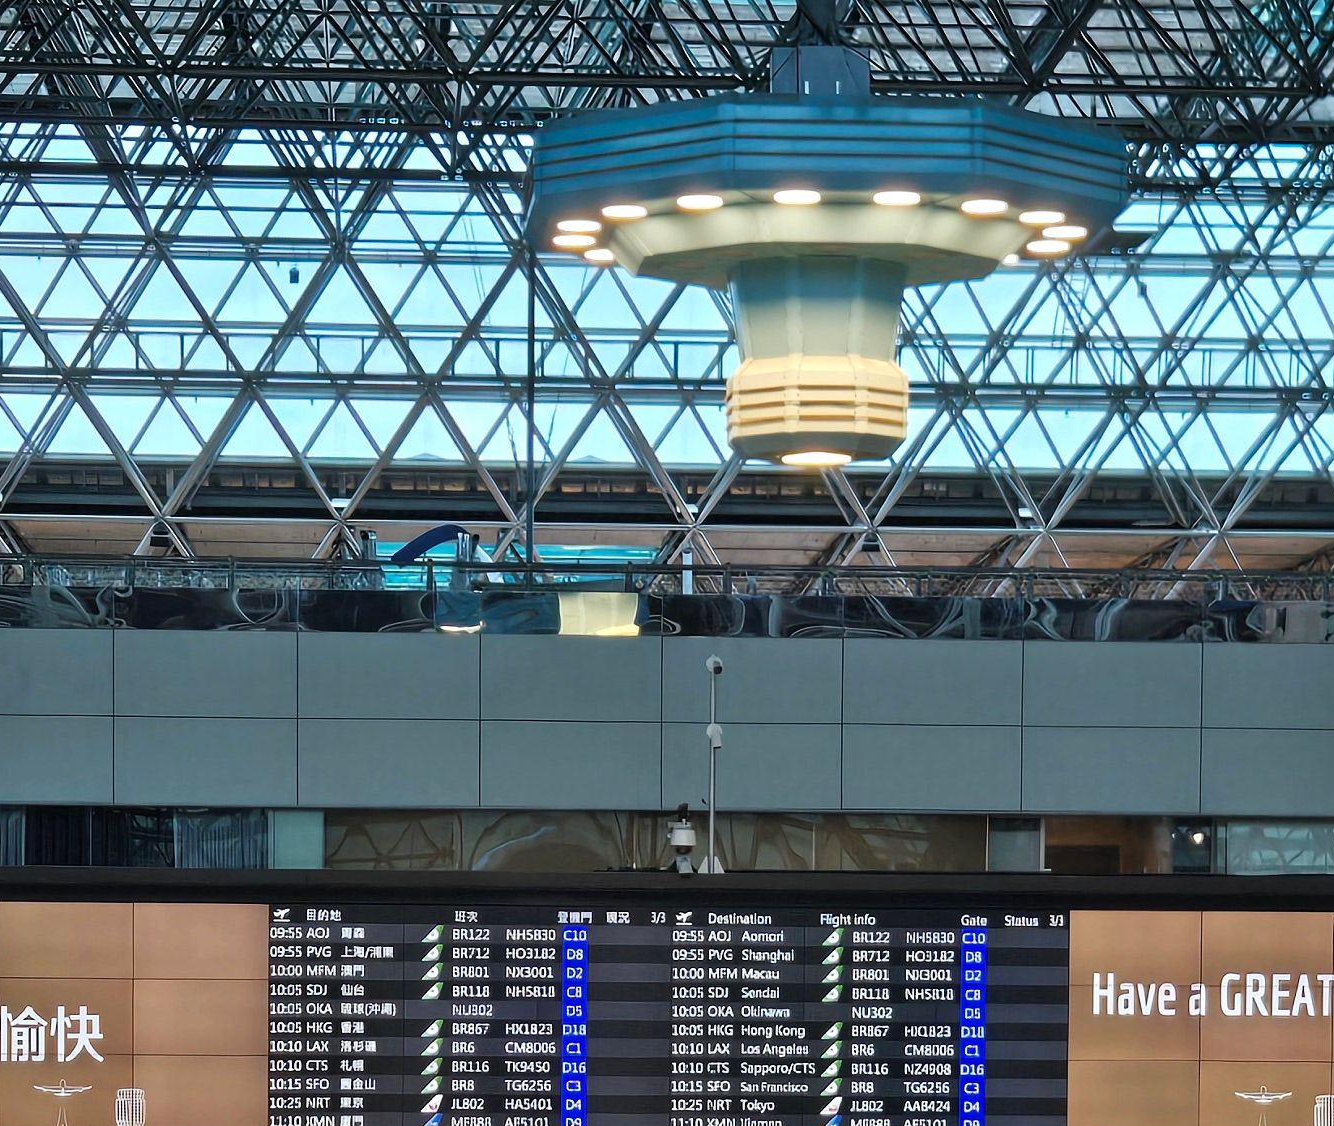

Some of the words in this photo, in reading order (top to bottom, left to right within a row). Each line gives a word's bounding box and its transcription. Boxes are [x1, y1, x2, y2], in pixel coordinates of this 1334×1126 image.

[269, 926, 303, 939] 09:55
[305, 926, 330, 939] AOJ
[563, 929, 587, 942] C10
[672, 929, 705, 942] 09:55
[962, 932, 986, 945] C10
[269, 945, 303, 958] 09:55
[306, 945, 332, 958] PVG
[566, 948, 584, 961] D8
[708, 948, 734, 961] PVG
[269, 964, 303, 977] 10:00
[306, 964, 337, 977] MFM
[566, 967, 583, 979] D2
[269, 983, 303, 997] 10:05
[306, 983, 328, 996] SDJ
[566, 986, 582, 998] C8
[1091, 972, 1177, 1016] Have
[1188, 983, 1207, 1017] a
[269, 1002, 303, 1015] 10:05
[305, 1002, 333, 1015] OKA
[566, 1005, 583, 1017] D5
[269, 1021, 302, 1034] 10:05
[306, 1021, 333, 1034] HKG
[562, 1024, 587, 1036] D18
[707, 1024, 734, 1036] HKG
[269, 1040, 303, 1053] 10:10
[306, 1040, 329, 1053] LAX
[566, 1042, 582, 1054] C1
[671, 1042, 704, 1055] 10:10
[707, 1042, 730, 1055] LAX
[269, 1059, 303, 1072] 10:10
[305, 1059, 329, 1072] CTS
[562, 1061, 587, 1074] D16
[960, 1063, 985, 1076] D16
[269, 1077, 302, 1091] 10:15
[305, 1077, 330, 1090] SFO
[565, 1080, 581, 1092] C3
[269, 1096, 302, 1109] 10:25
[305, 1096, 331, 1109] NRT
[565, 1098, 582, 1111] D4
[671, 1098, 703, 1111] 10:25
[706, 1098, 733, 1111] NRT
